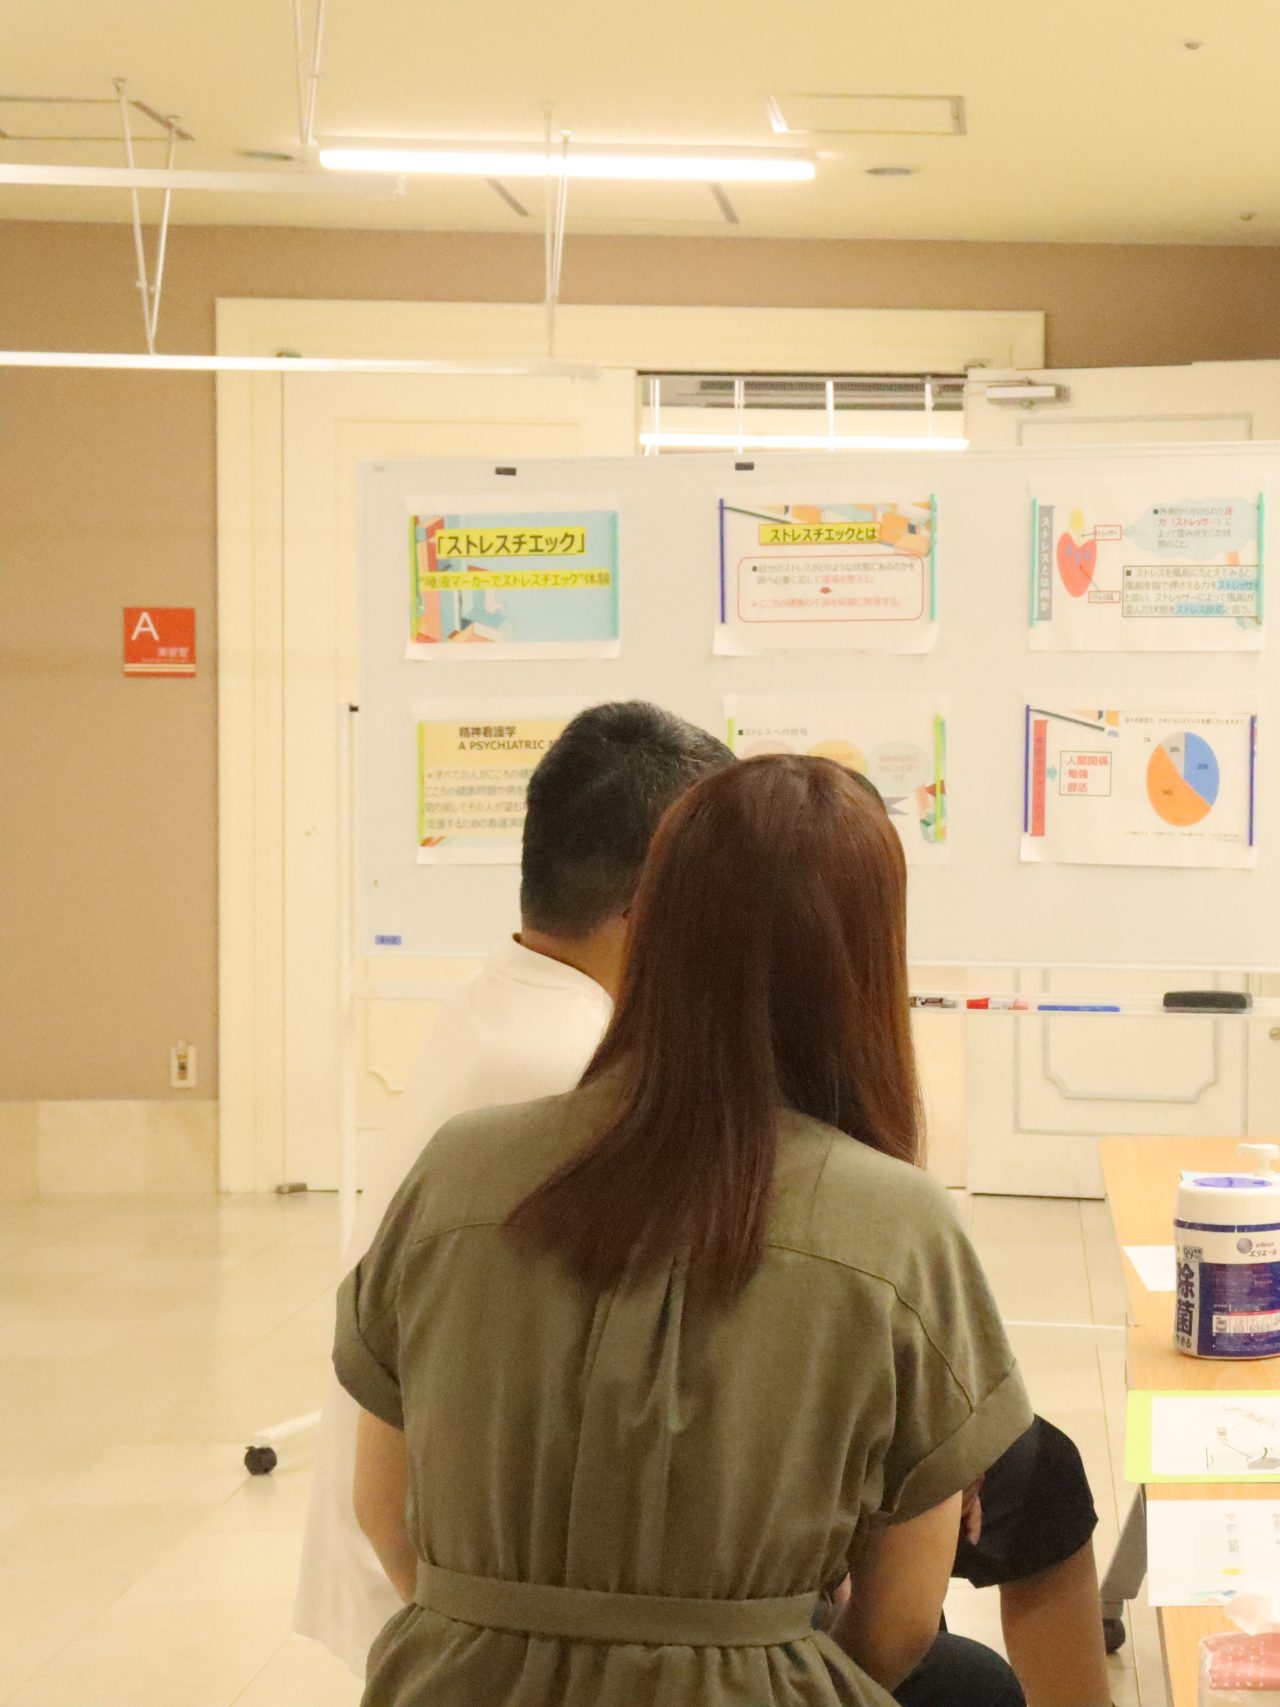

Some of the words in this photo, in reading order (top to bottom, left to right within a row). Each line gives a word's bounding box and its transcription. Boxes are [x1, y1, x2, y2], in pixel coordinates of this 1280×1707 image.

[131, 611, 160, 641] A
[458, 741, 466, 750] A
[470, 740, 545, 750] PSYCHIATRIC
